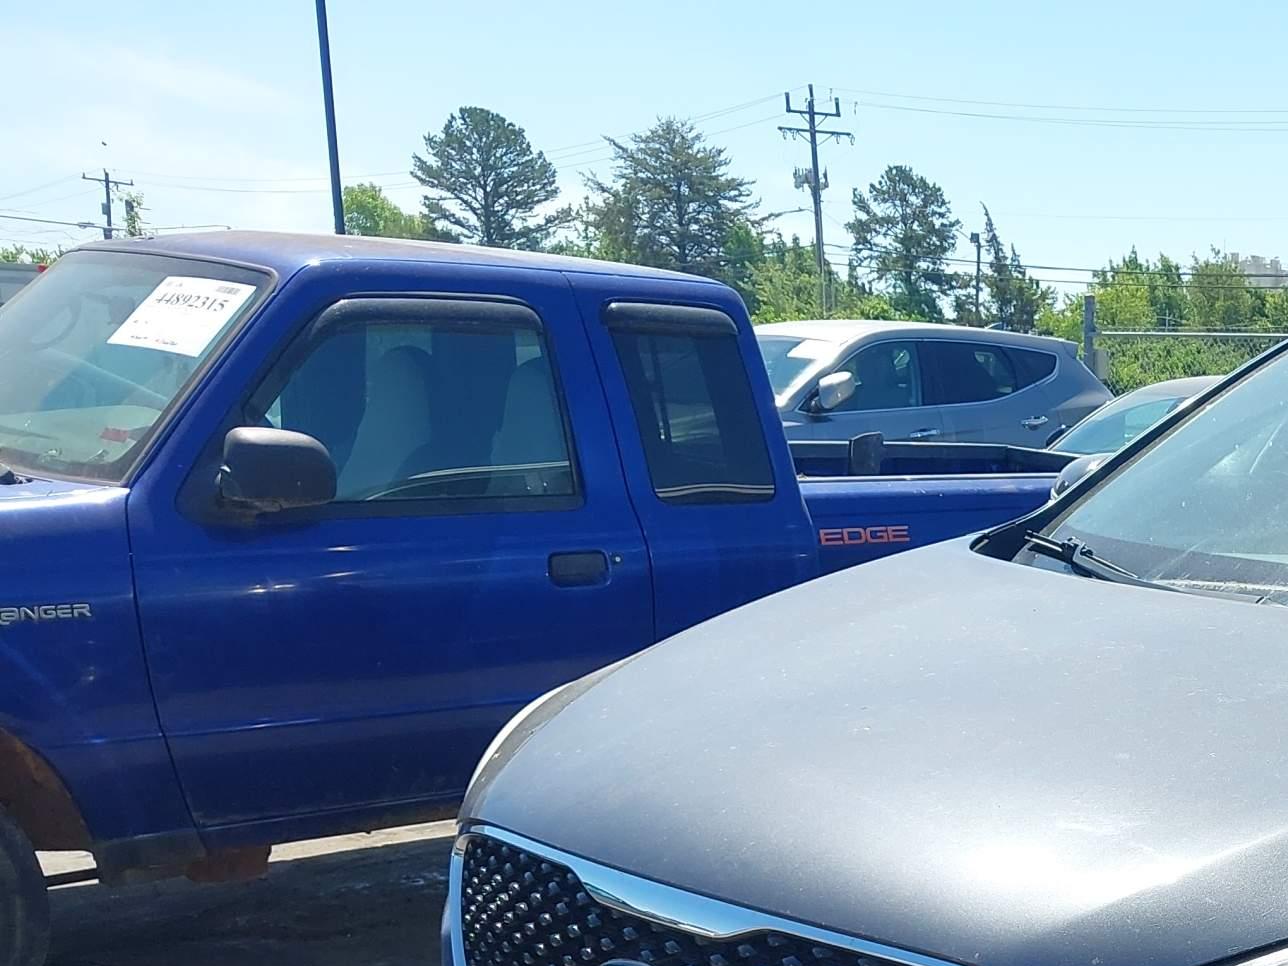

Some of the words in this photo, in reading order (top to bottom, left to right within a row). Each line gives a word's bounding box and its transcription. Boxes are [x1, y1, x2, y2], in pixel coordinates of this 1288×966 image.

[155, 291, 230, 312] 44892315
[819, 525, 911, 546] EDGE
[0, 603, 92, 626] ANGER
